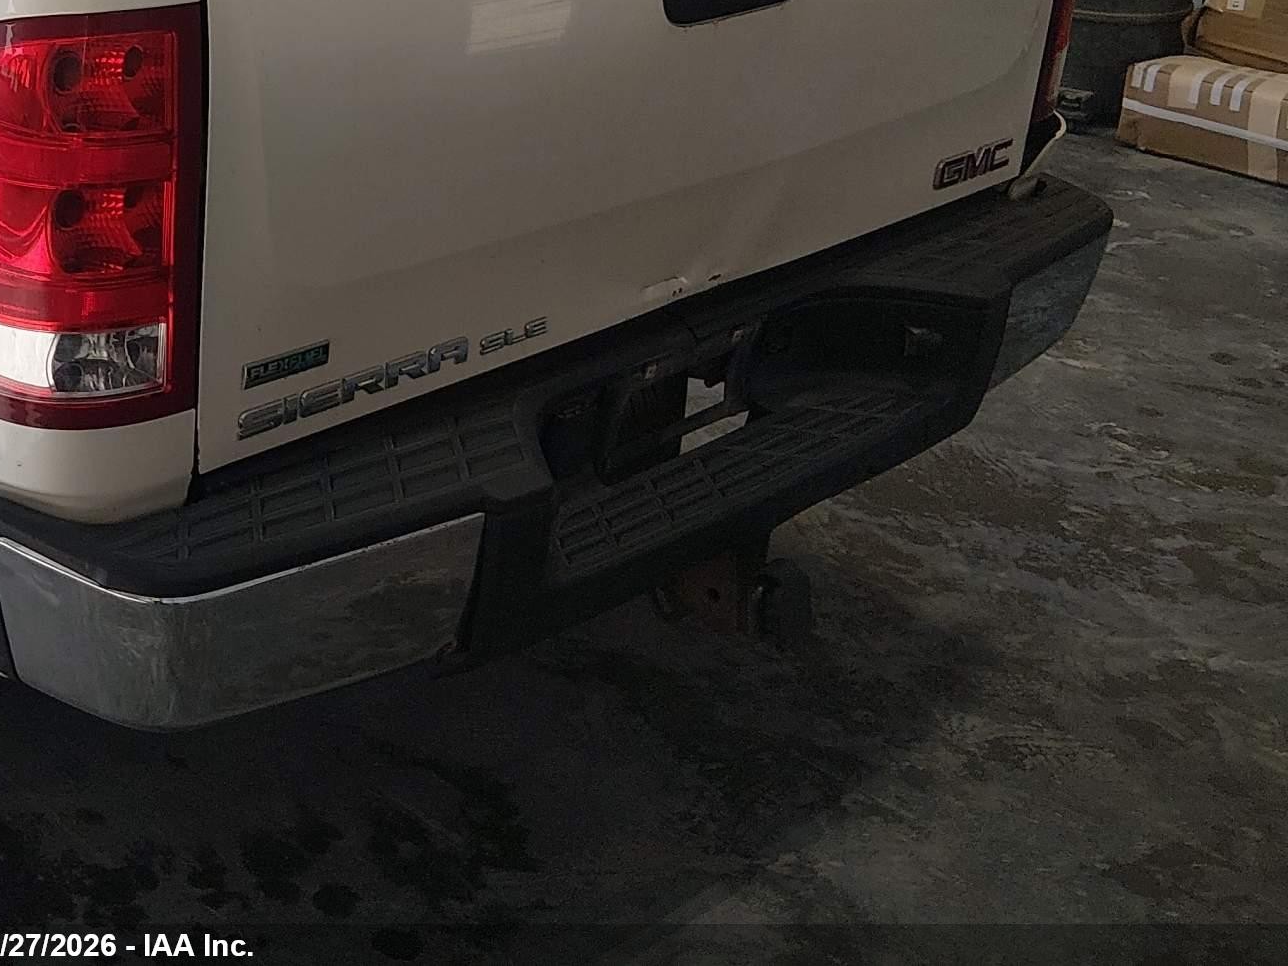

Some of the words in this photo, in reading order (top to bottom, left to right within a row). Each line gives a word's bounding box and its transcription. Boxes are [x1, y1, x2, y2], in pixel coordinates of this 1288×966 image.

[932, 138, 1014, 190] GMC
[237, 335, 470, 441] SIERRA
[479, 315, 549, 356] SLE
